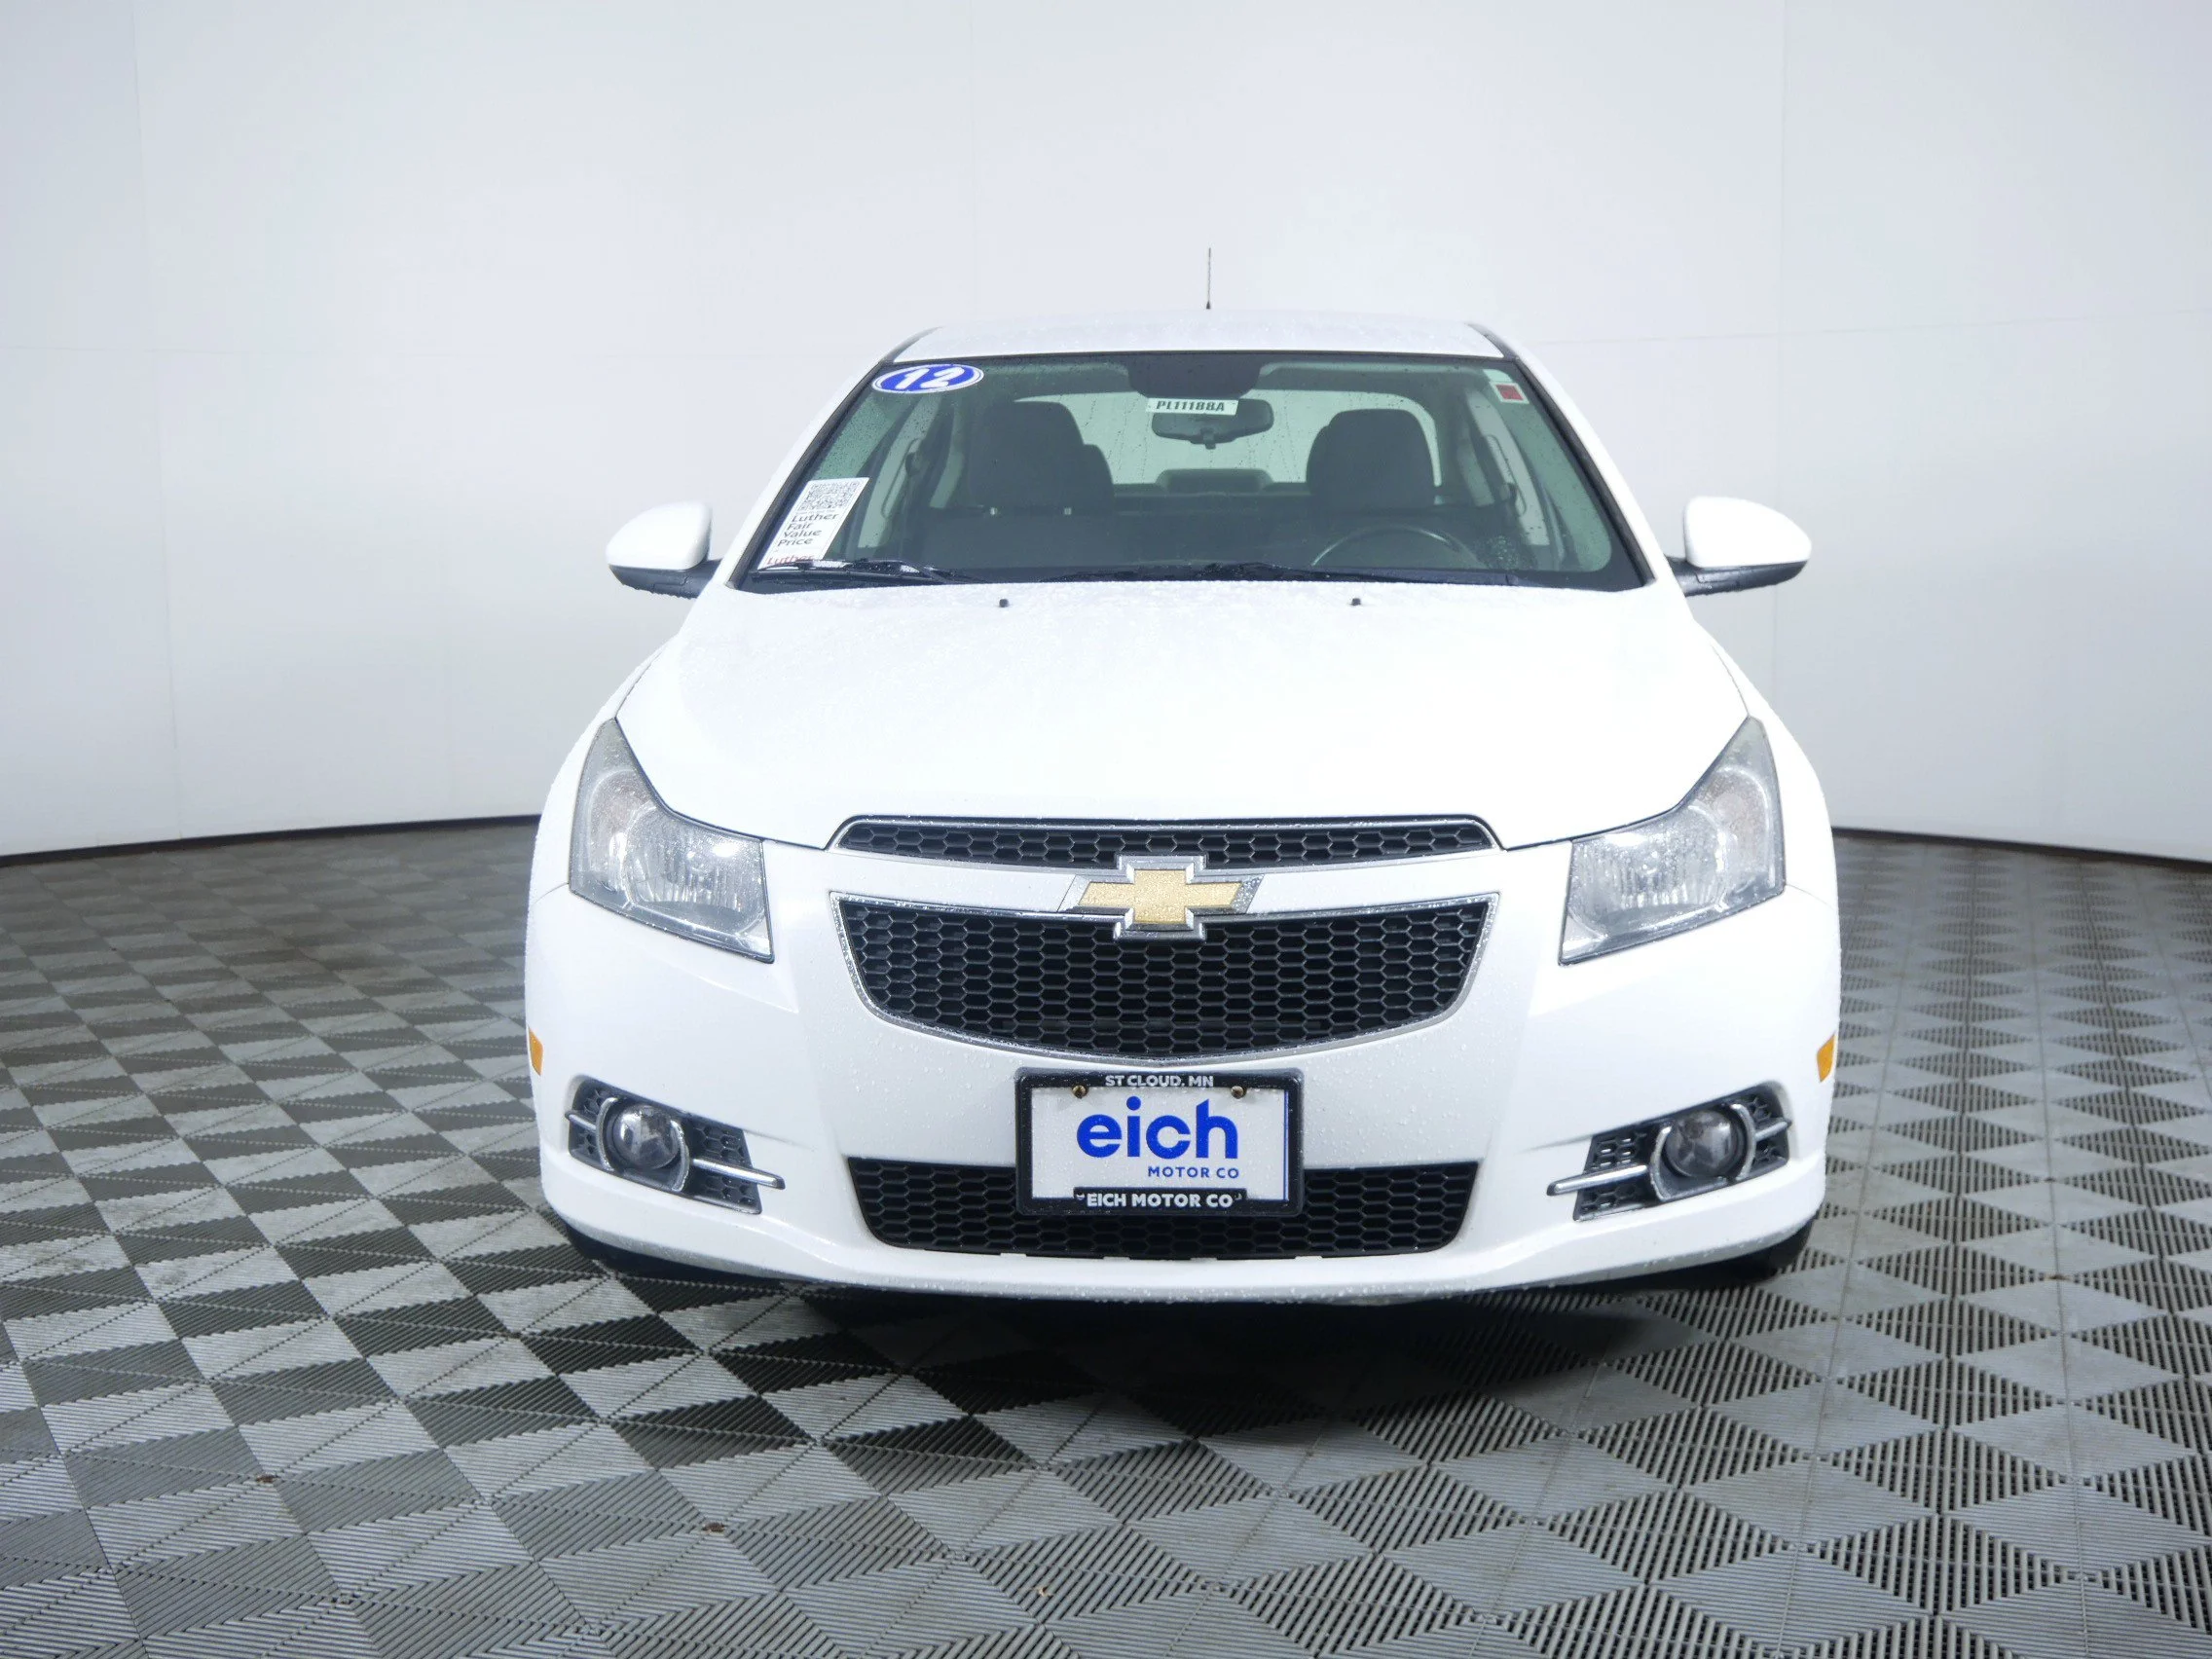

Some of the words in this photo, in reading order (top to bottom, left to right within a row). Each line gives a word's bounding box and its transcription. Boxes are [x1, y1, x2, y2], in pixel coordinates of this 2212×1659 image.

[895, 366, 965, 389] 12
[792, 513, 838, 522] Luther
[1105, 1075, 1124, 1087] ST
[1189, 1075, 1214, 1088] MN
[1077, 1096, 1238, 1159] eich
[1148, 1166, 1210, 1178] MOTOR
[1216, 1167, 1239, 1179] CO
[1087, 1194, 1125, 1207] EICH
[1131, 1194, 1200, 1208] MOTOR
[1205, 1195, 1234, 1208] CO
